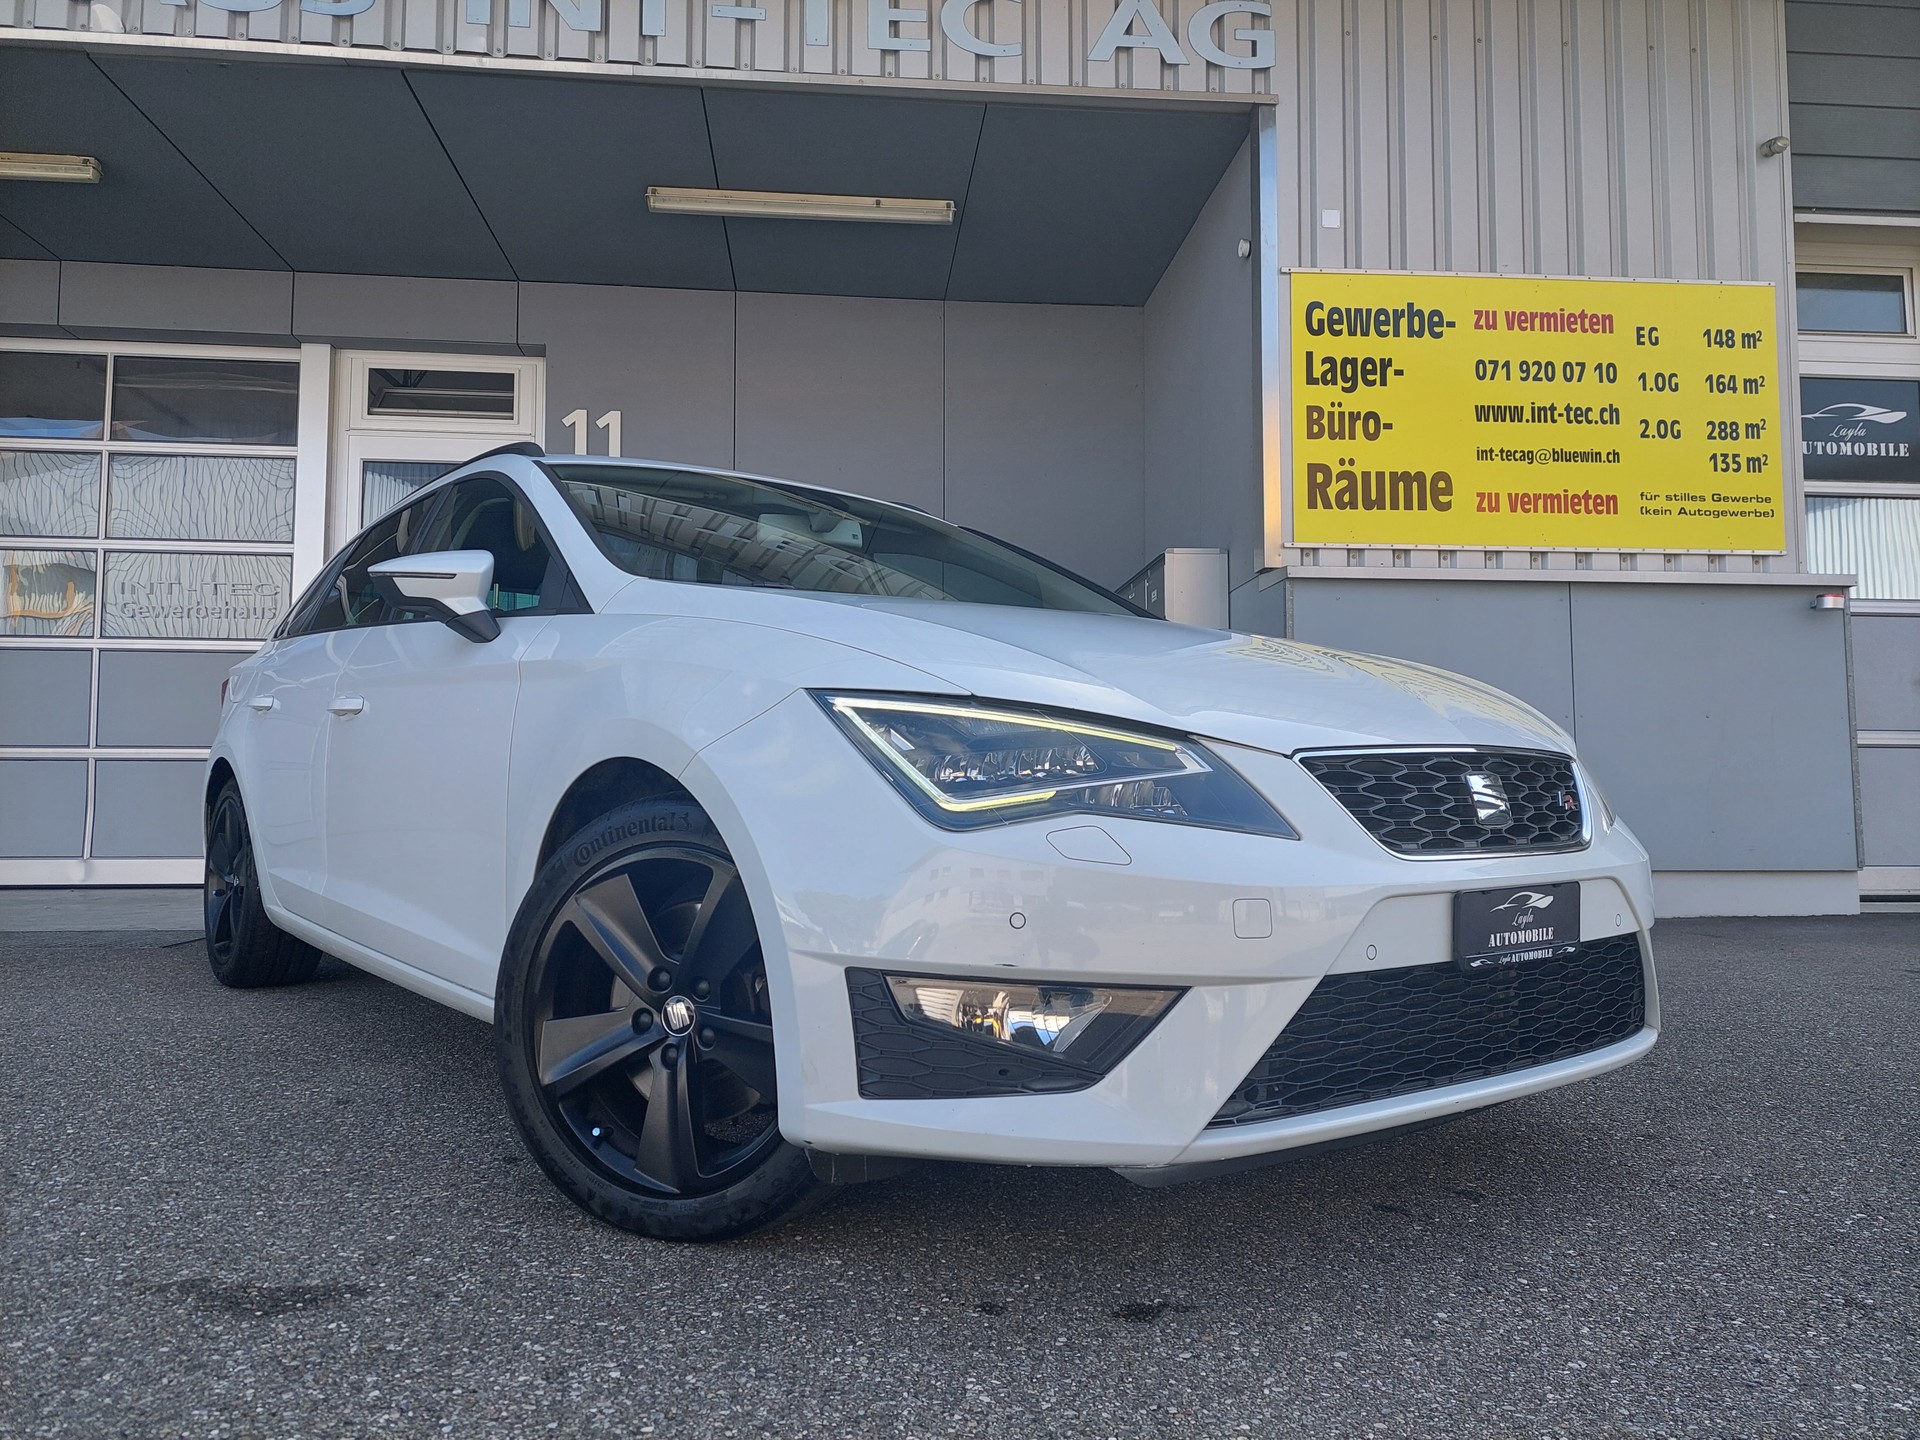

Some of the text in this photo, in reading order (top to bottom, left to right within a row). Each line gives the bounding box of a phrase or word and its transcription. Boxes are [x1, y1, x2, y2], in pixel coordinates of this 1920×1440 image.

[1087, 0, 1276, 69] AG
[1305, 300, 1456, 339] Gewerbe-
[1473, 307, 1615, 335] zu vermieten
[1635, 326, 1660, 347] EG
[1703, 328, 1736, 349] 148
[1305, 350, 1405, 394] Lager-
[1474, 359, 1618, 384] 071 920 07 10
[1704, 373, 1738, 394] 164
[1305, 400, 1394, 442] Büro-
[1474, 401, 1621, 426] www.int-tec.ch
[561, 409, 622, 458] 11
[1706, 420, 1740, 441] 288
[1829, 422, 1867, 441] Layla
[1476, 446, 1621, 465] int-tecag@bluewin.ch
[1801, 440, 1910, 457] UTOMOBILE
[1708, 452, 1742, 473] 135
[1306, 457, 1454, 513] Räume
[1475, 488, 1619, 515] zu vermieten
[1639, 491, 1772, 504] für stilles Gewerbe
[1640, 506, 1775, 519] (kein Autogewerbe)
[120, 581, 281, 597] INT-TEC
[120, 600, 278, 621] Gewerbehaus
[573, 811, 677, 867] Continental
[1488, 926, 1555, 948] AUTOMOBILE
[1511, 948, 1554, 964] AUTOMOBILE
